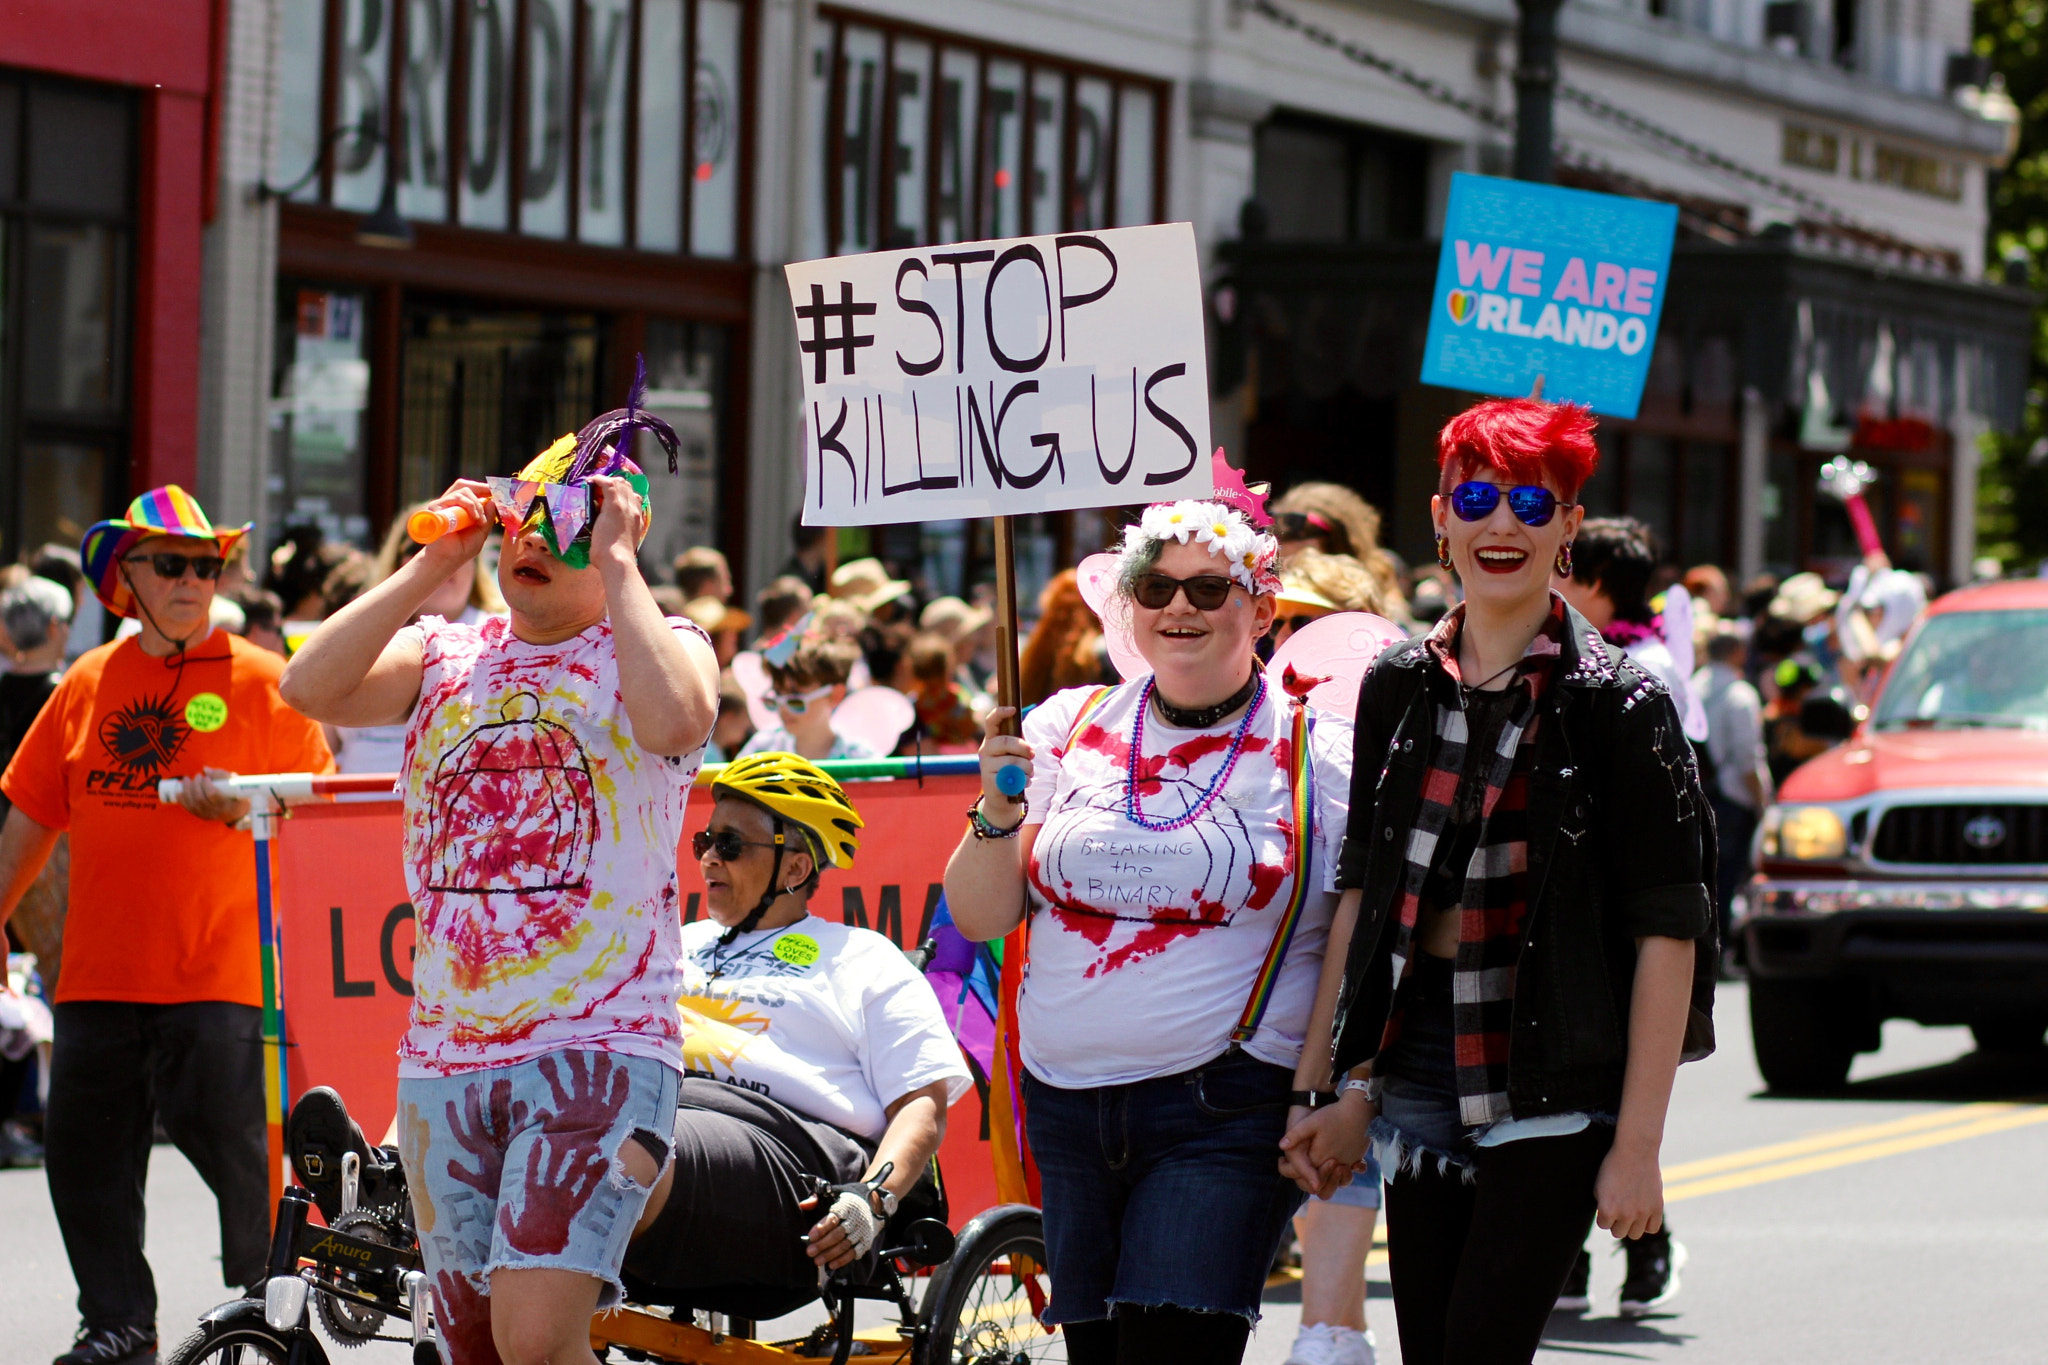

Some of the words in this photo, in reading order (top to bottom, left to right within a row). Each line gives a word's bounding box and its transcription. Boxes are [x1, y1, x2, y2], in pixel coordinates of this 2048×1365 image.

[1454, 239, 1546, 298] WE
[1552, 256, 1658, 316] ARE
[813, 380, 1067, 510] KILLING
[1091, 362, 1198, 487] US
[1213, 486, 1239, 499] obile
[86, 770, 184, 793] PFLA
[1080, 837, 1193, 856] BREAKING
[1110, 860, 1153, 878] the
[1088, 877, 1178, 905] BINARY
[776, 943, 813, 961] LOVES
[782, 952, 800, 963] ME
[310, 1234, 372, 1262] Anura
